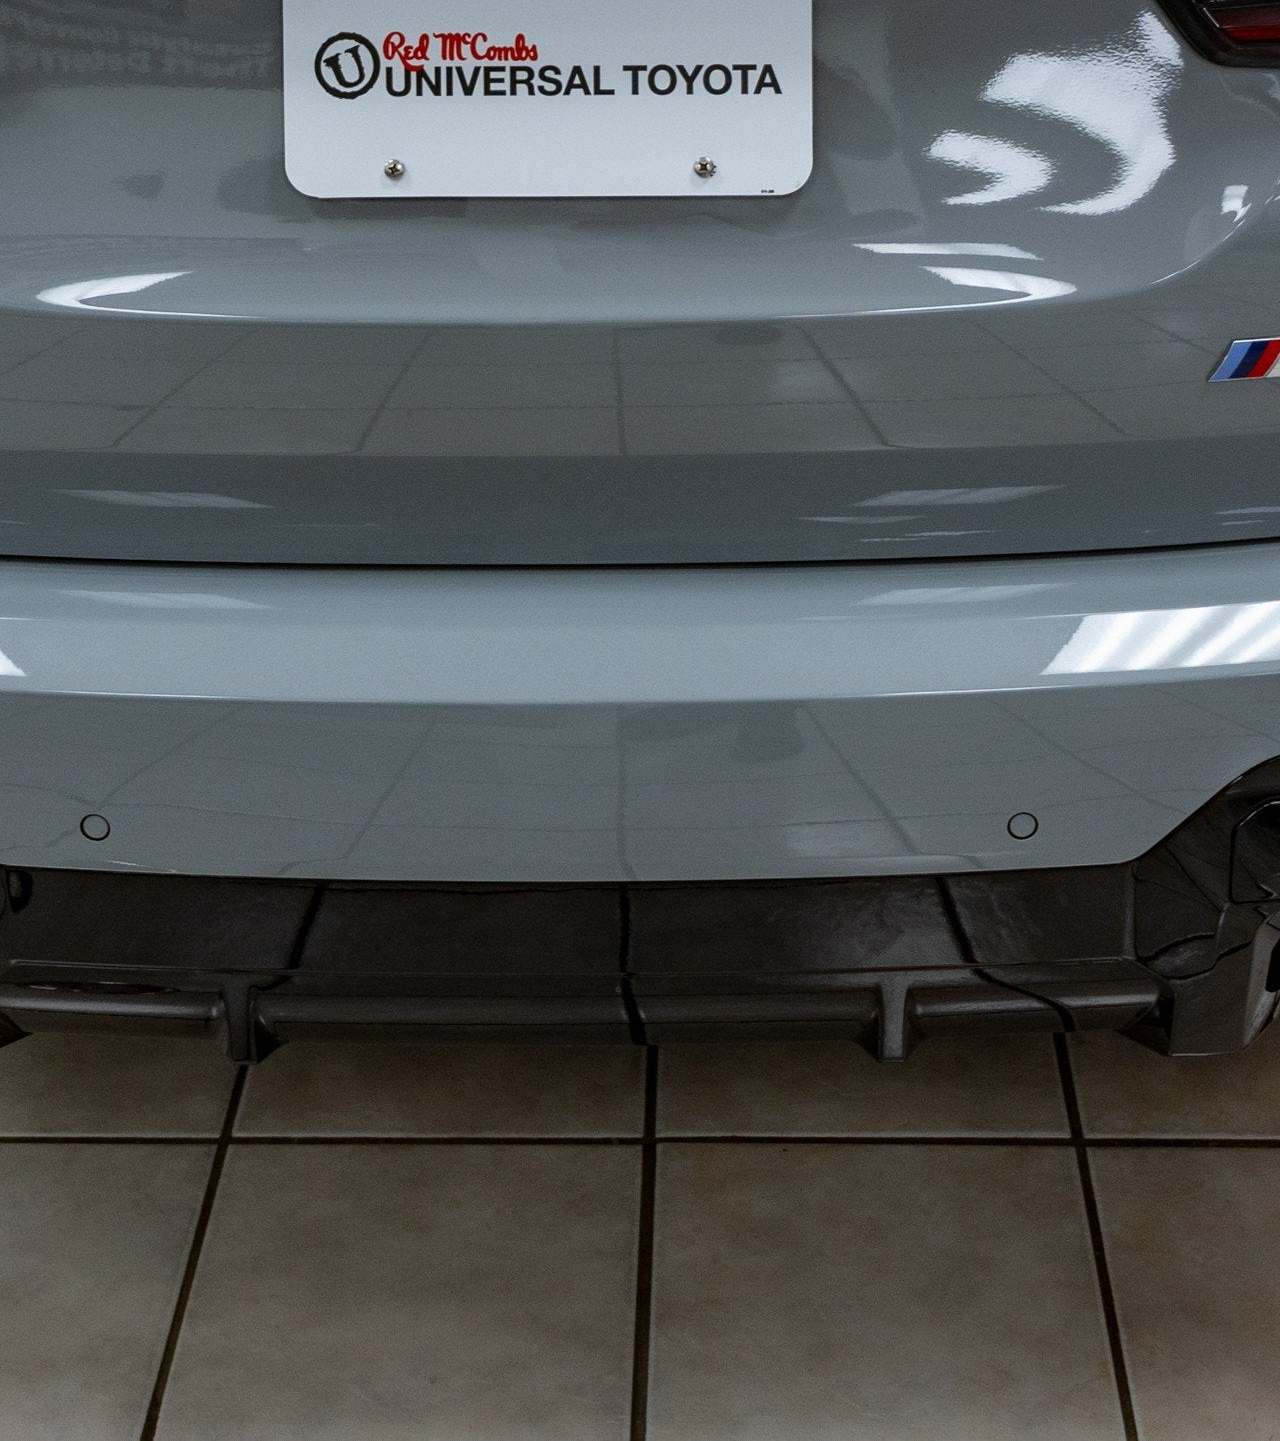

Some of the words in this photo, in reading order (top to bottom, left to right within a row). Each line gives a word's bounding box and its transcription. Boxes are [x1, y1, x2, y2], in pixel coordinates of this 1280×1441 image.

[382, 31, 430, 72] Red
[433, 31, 539, 62] McCombs
[385, 64, 616, 98] UNIVERSAL
[622, 63, 783, 96] TOYOTA
